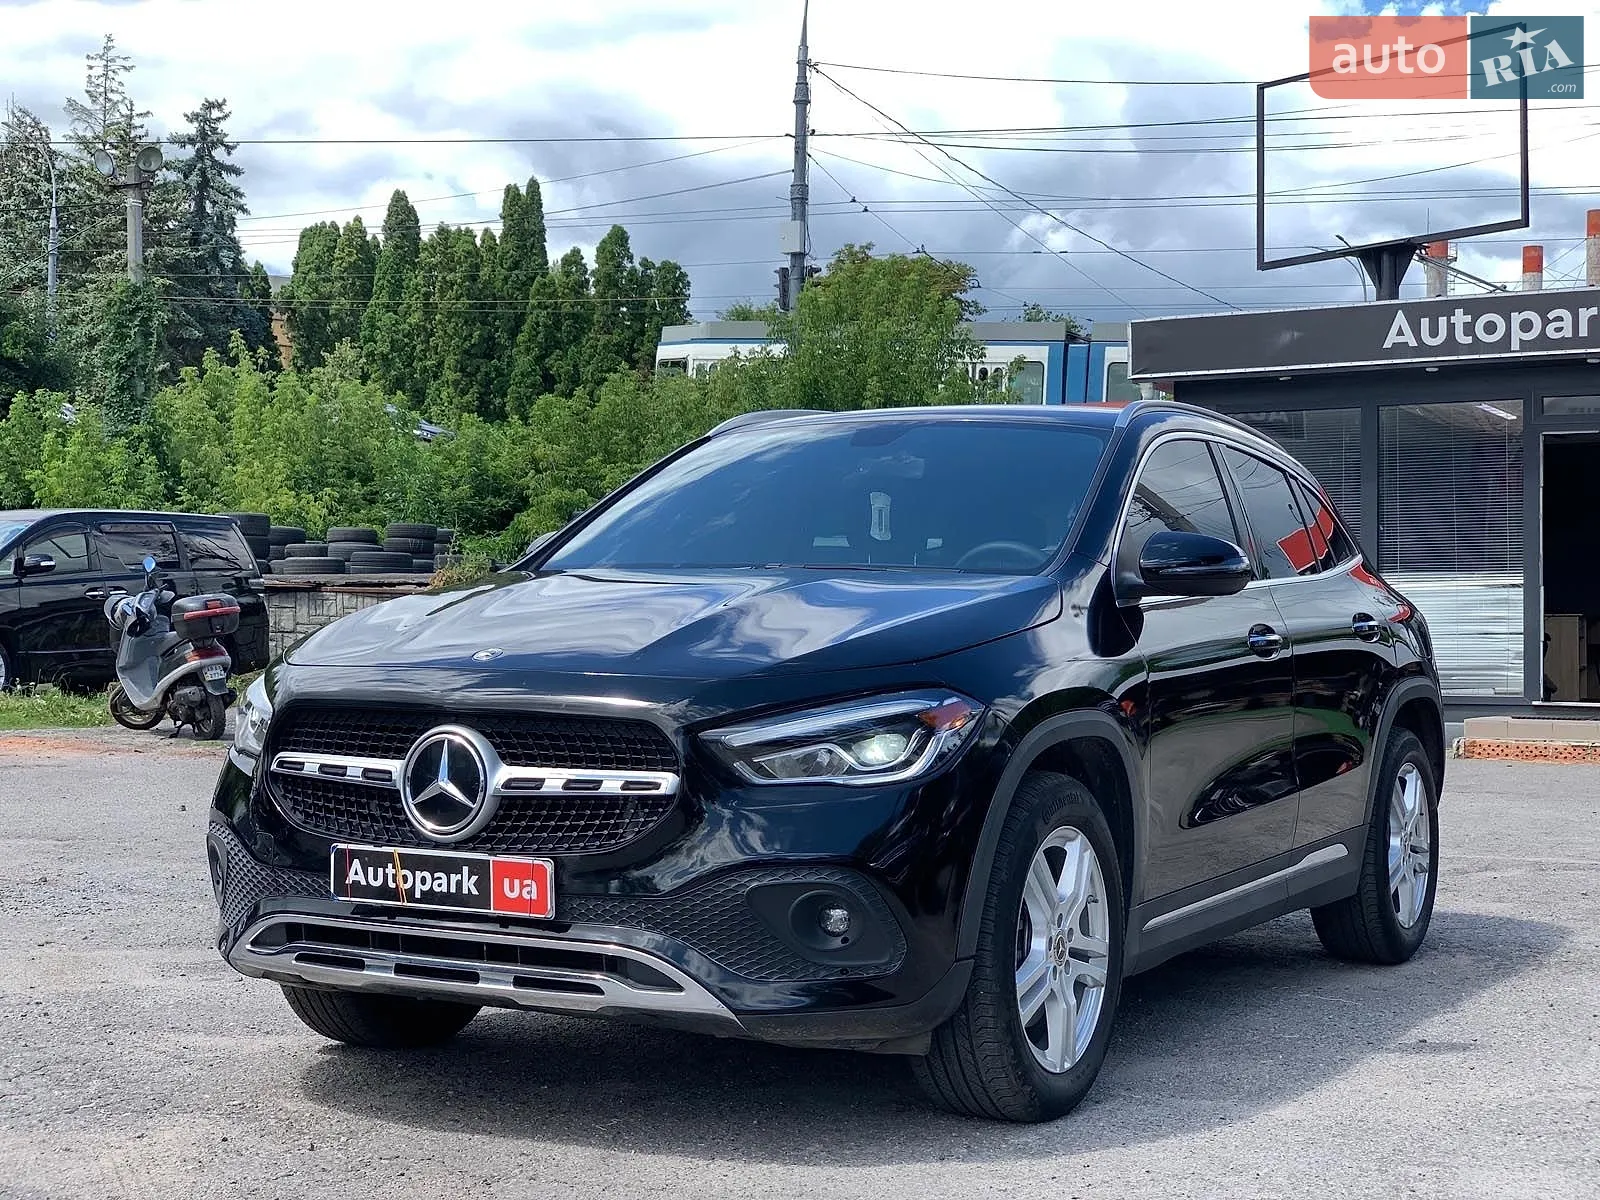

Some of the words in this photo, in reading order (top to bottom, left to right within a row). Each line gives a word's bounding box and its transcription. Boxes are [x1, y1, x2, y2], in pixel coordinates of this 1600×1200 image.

[1382, 306, 1598, 351] Autopar
[345, 858, 480, 899] Autopark
[503, 877, 538, 900] ua
